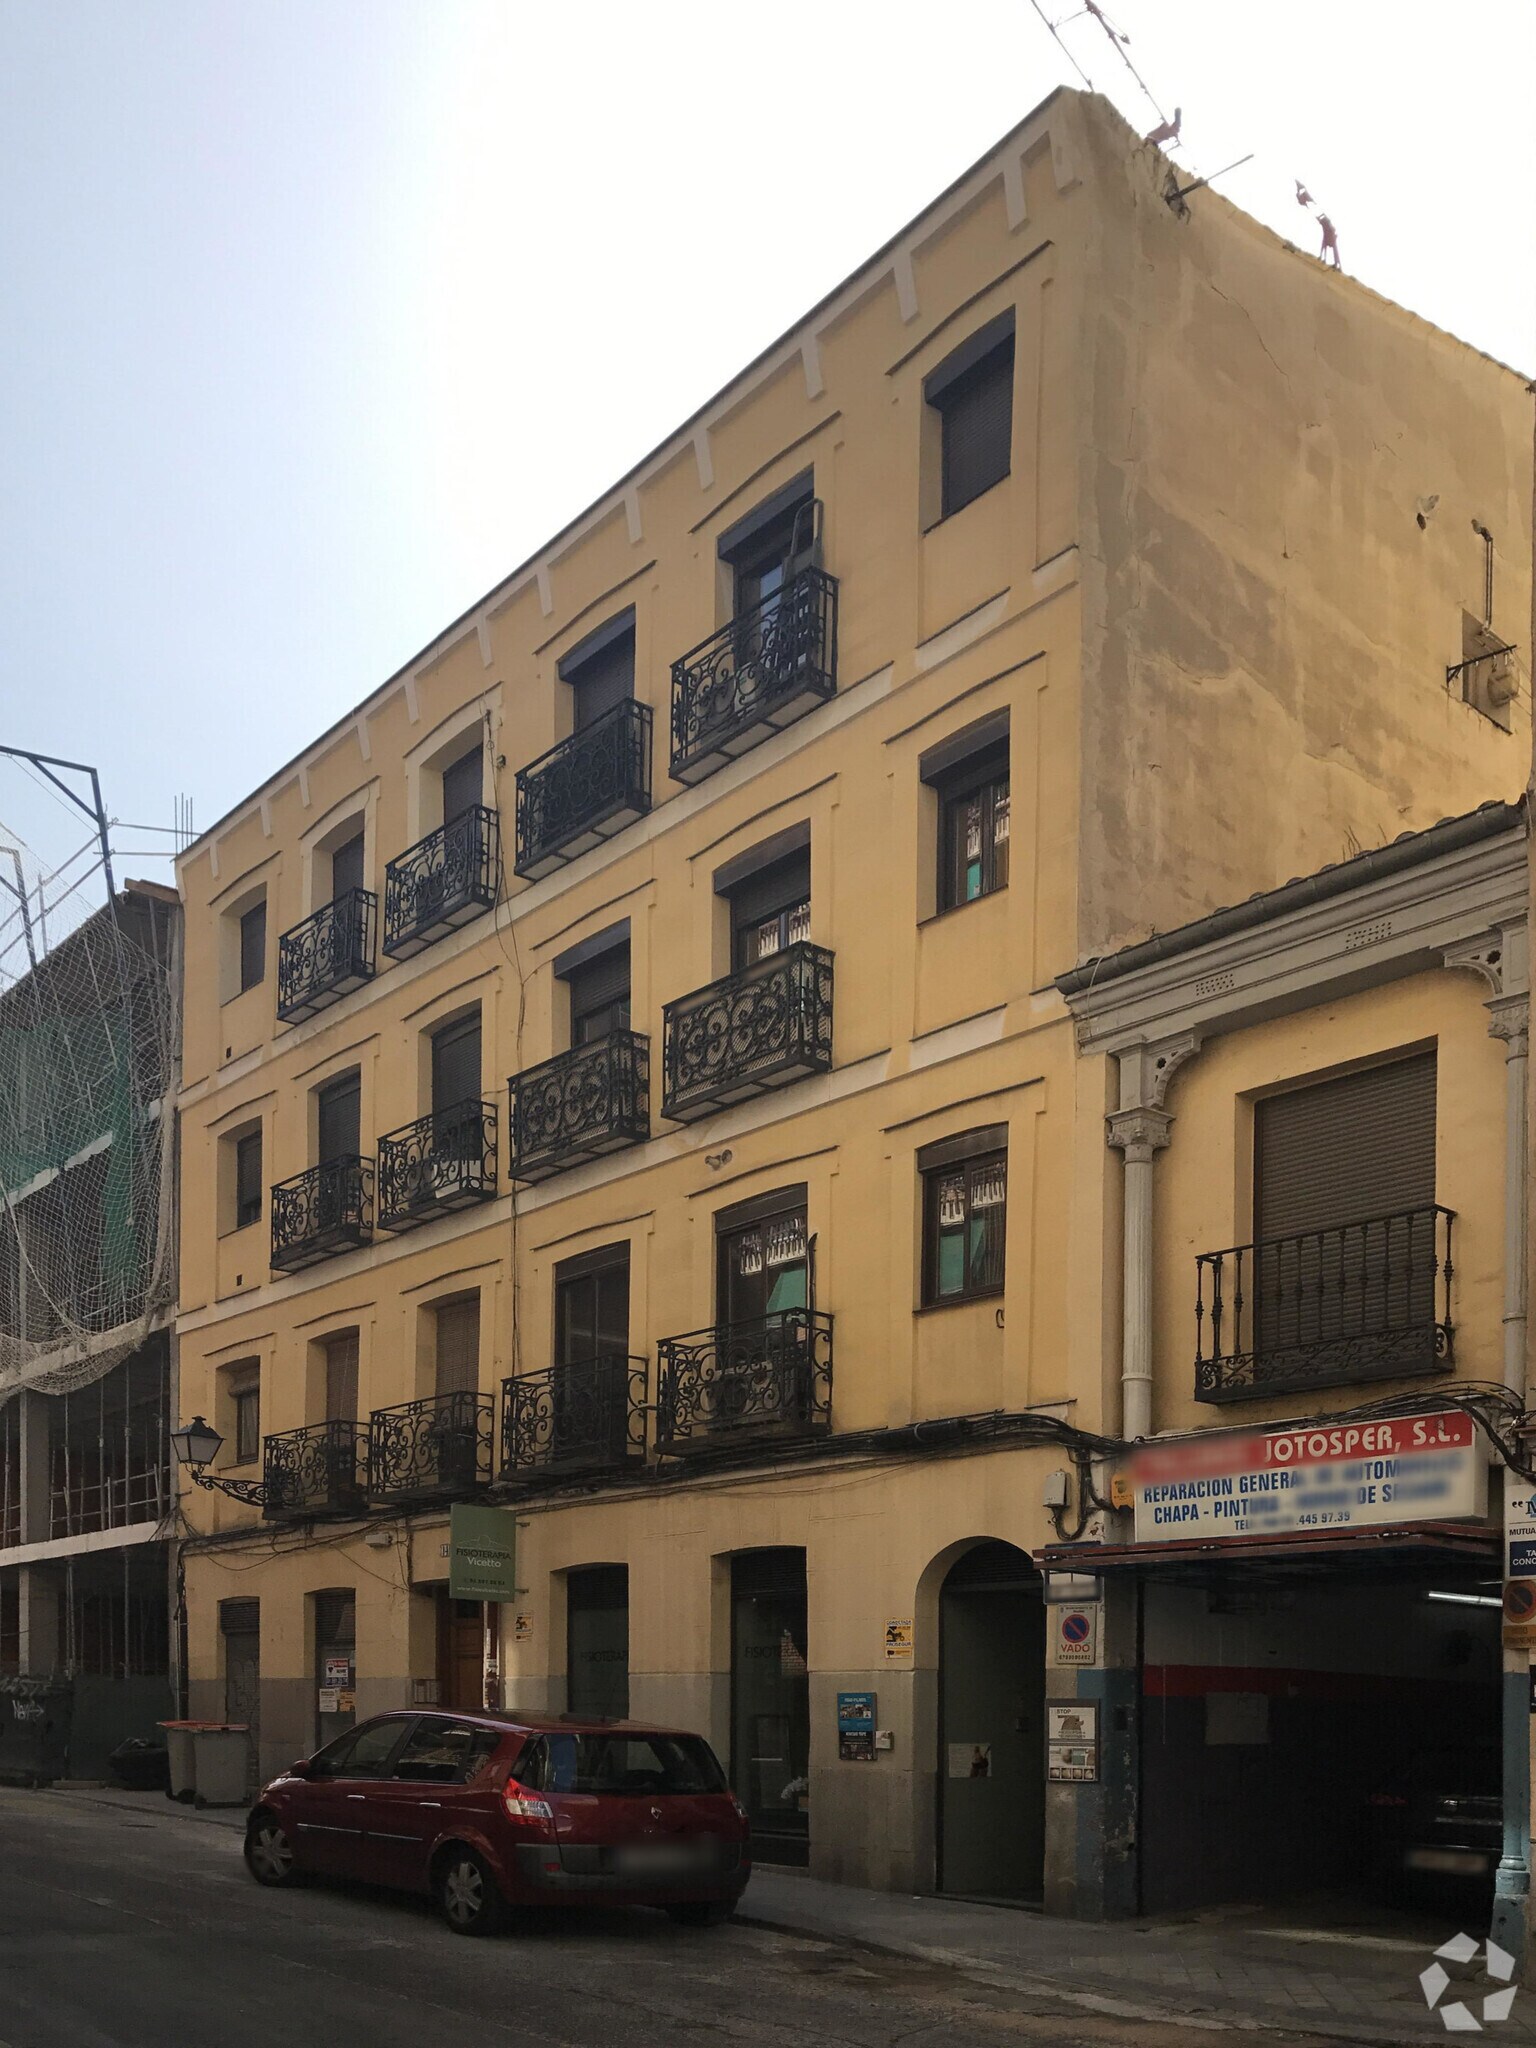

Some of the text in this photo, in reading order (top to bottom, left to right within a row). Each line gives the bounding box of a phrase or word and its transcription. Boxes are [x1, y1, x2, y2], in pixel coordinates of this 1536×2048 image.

[1413, 1420, 1461, 1446] S.L.
[1144, 1478, 1232, 1503] REPARACION
[1239, 1470, 1303, 1494] GENERA
[1154, 1504, 1199, 1524] CHAPA
[456, 1548, 511, 1560] FISIOTERAPIA
[467, 1556, 502, 1568] Vicetto
[1060, 1644, 1090, 1653] VADO
